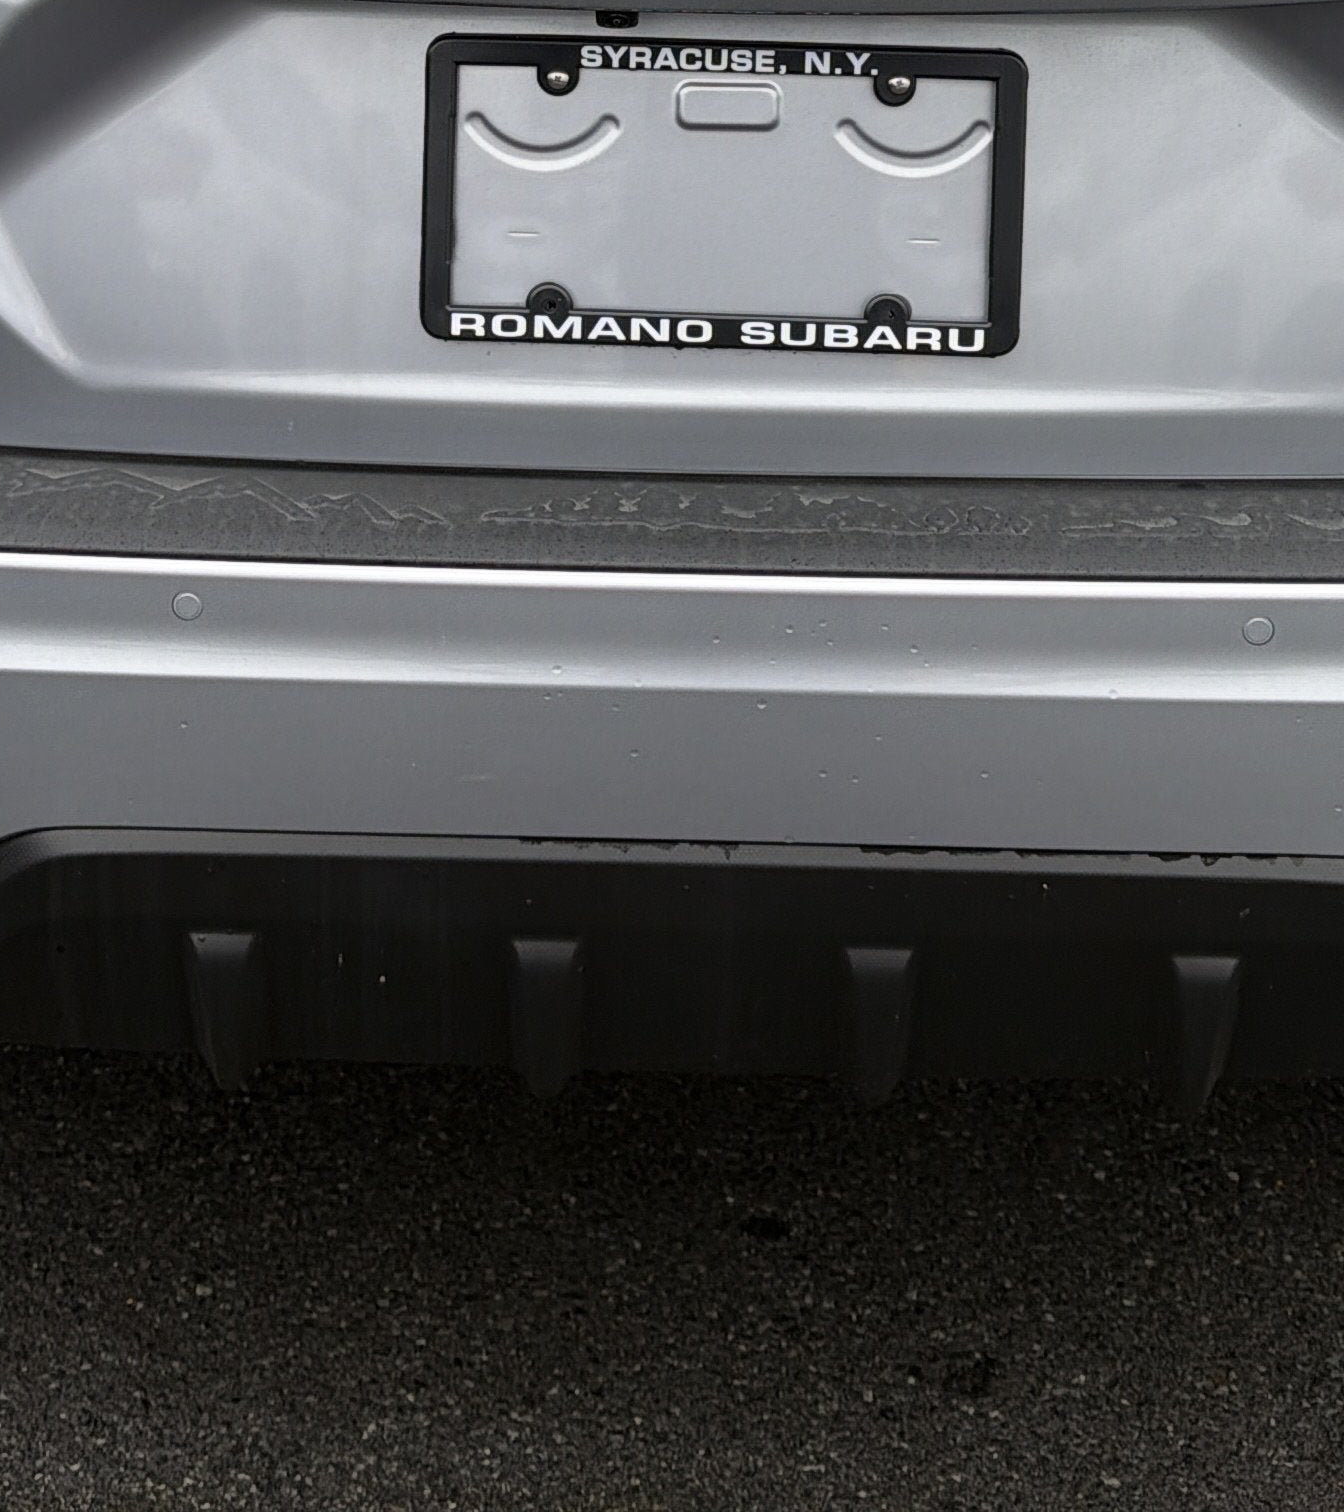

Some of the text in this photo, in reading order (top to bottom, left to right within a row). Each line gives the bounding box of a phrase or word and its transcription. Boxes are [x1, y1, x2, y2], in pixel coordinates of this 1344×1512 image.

[580, 44, 880, 76] SYRACUSE, N.Y.
[450, 311, 986, 353] ROMANO SUBARU
